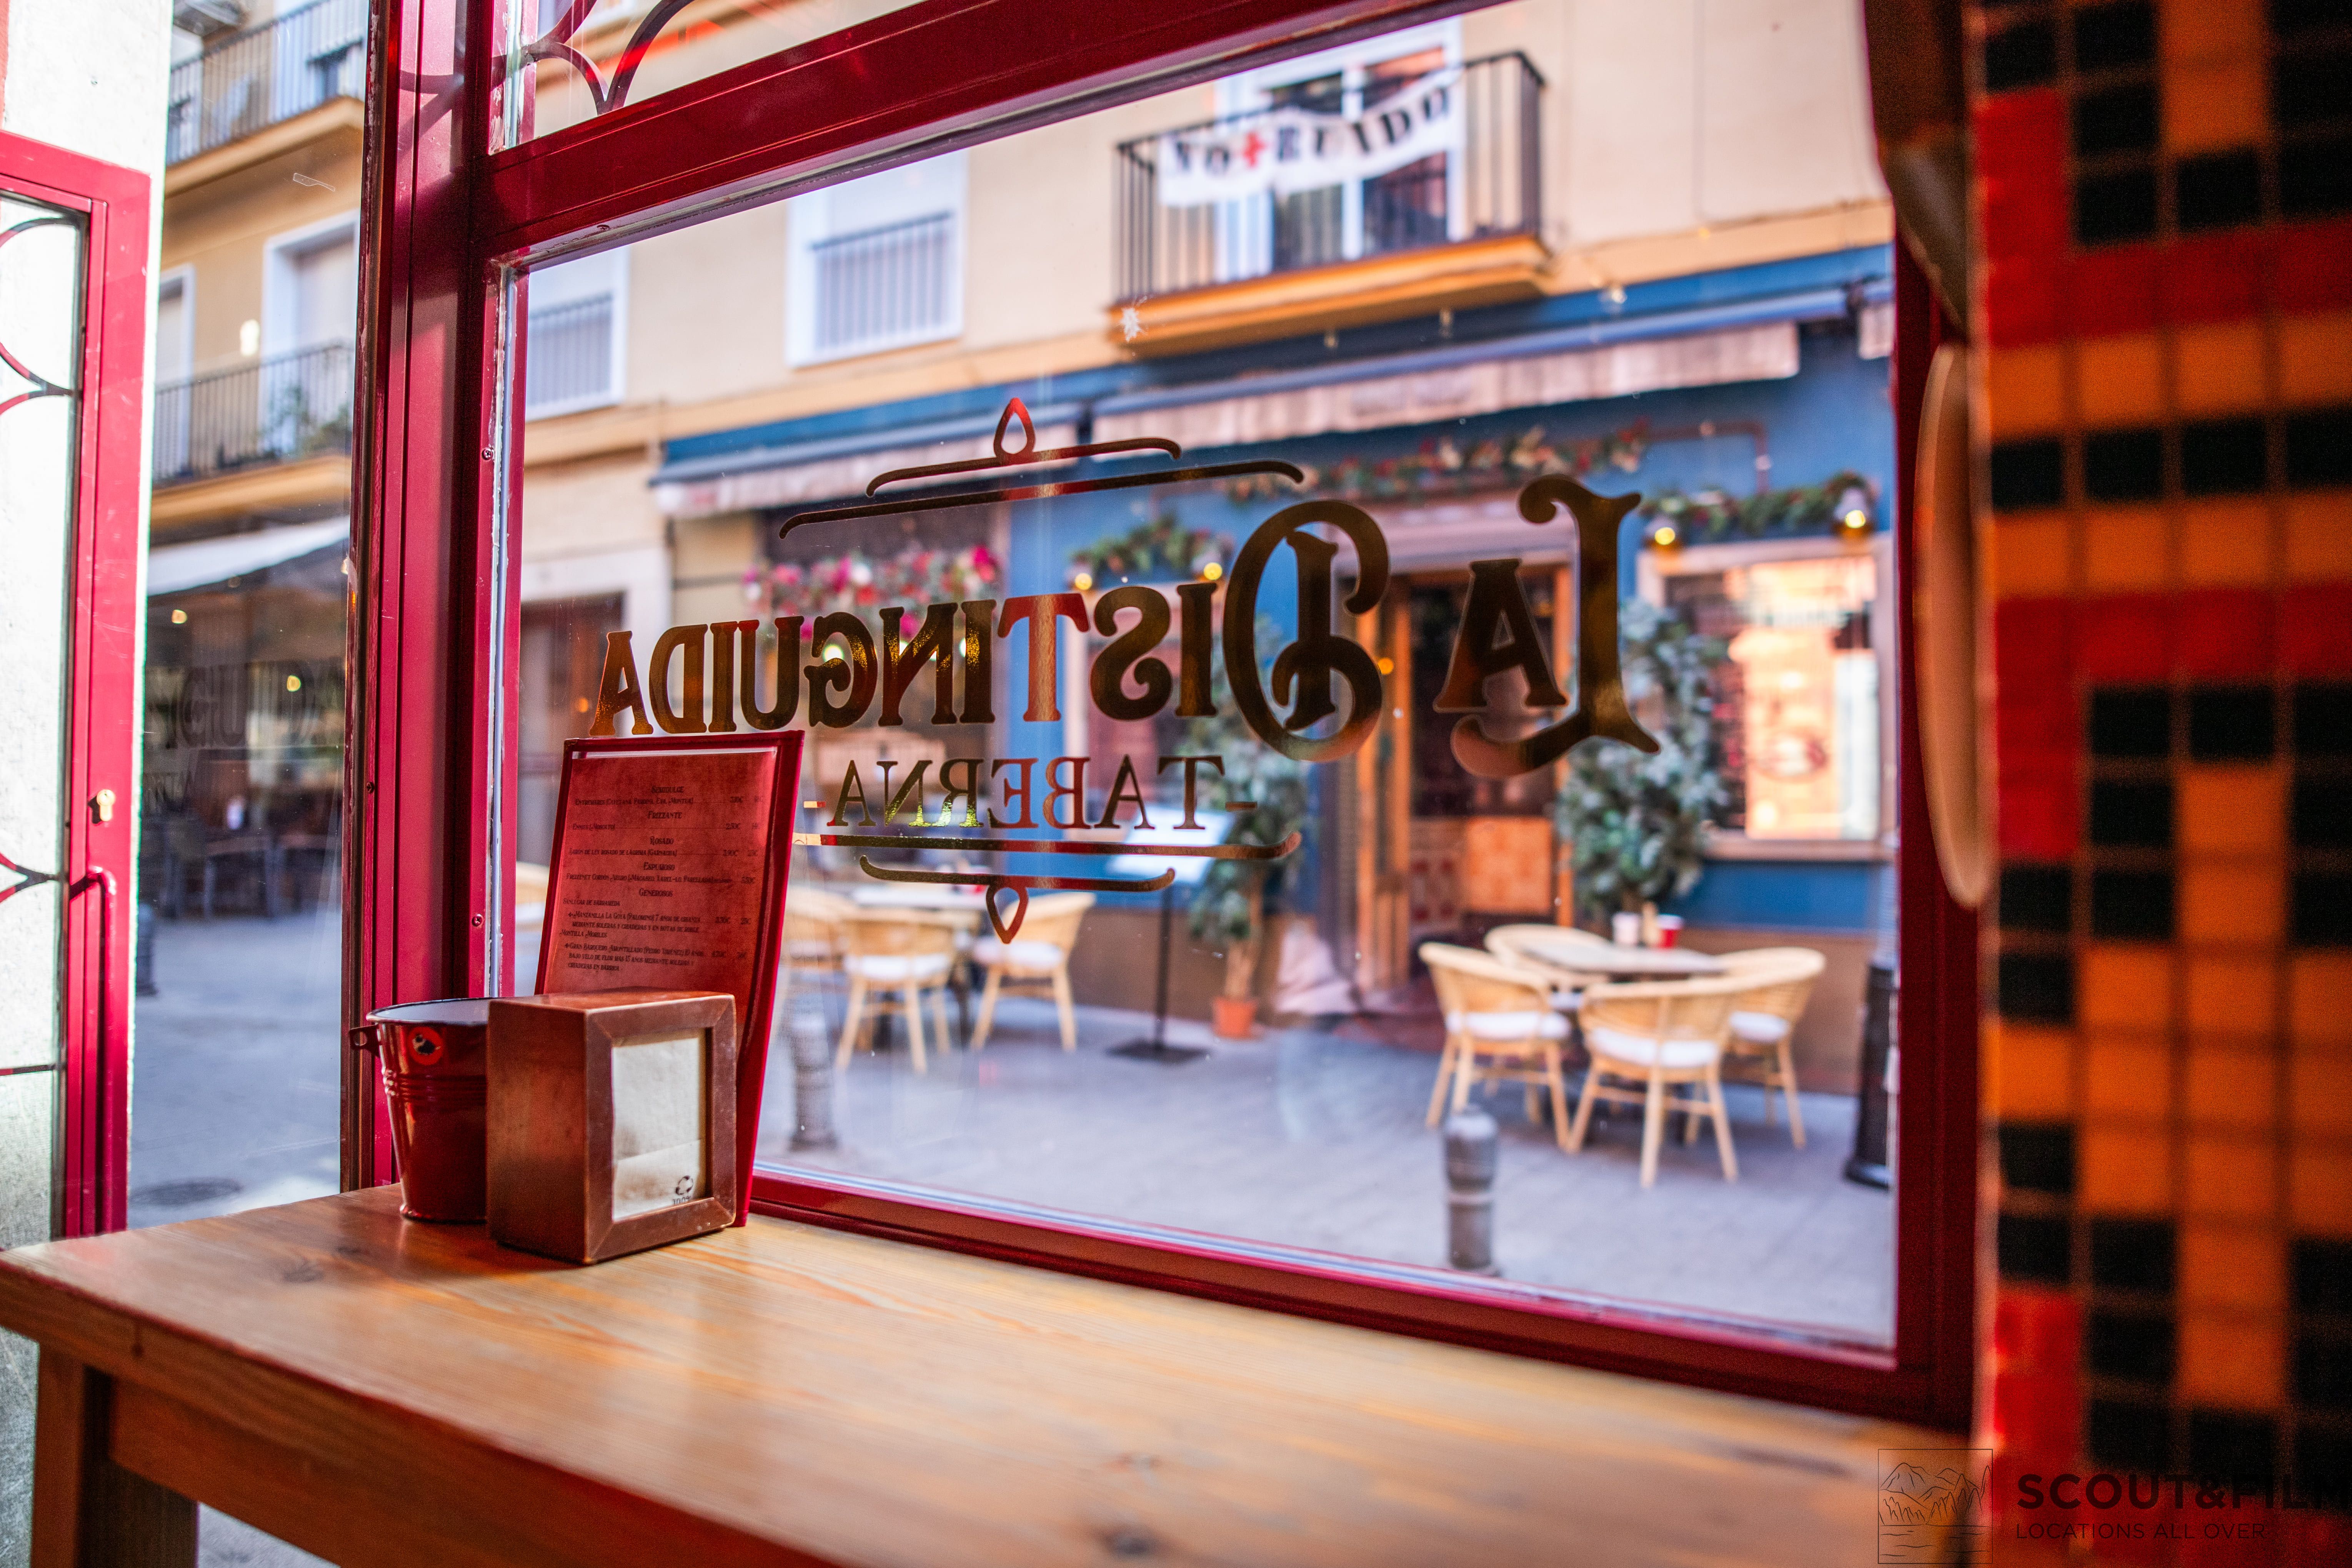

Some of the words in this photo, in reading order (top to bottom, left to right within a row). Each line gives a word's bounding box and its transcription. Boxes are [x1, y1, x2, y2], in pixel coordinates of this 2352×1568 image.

[648, 811, 682, 819] FRIZZANTE
[650, 836, 674, 845] ROSADO
[643, 862, 675, 870] ESPUMOSO
[639, 888, 673, 897] GENEROSOS
